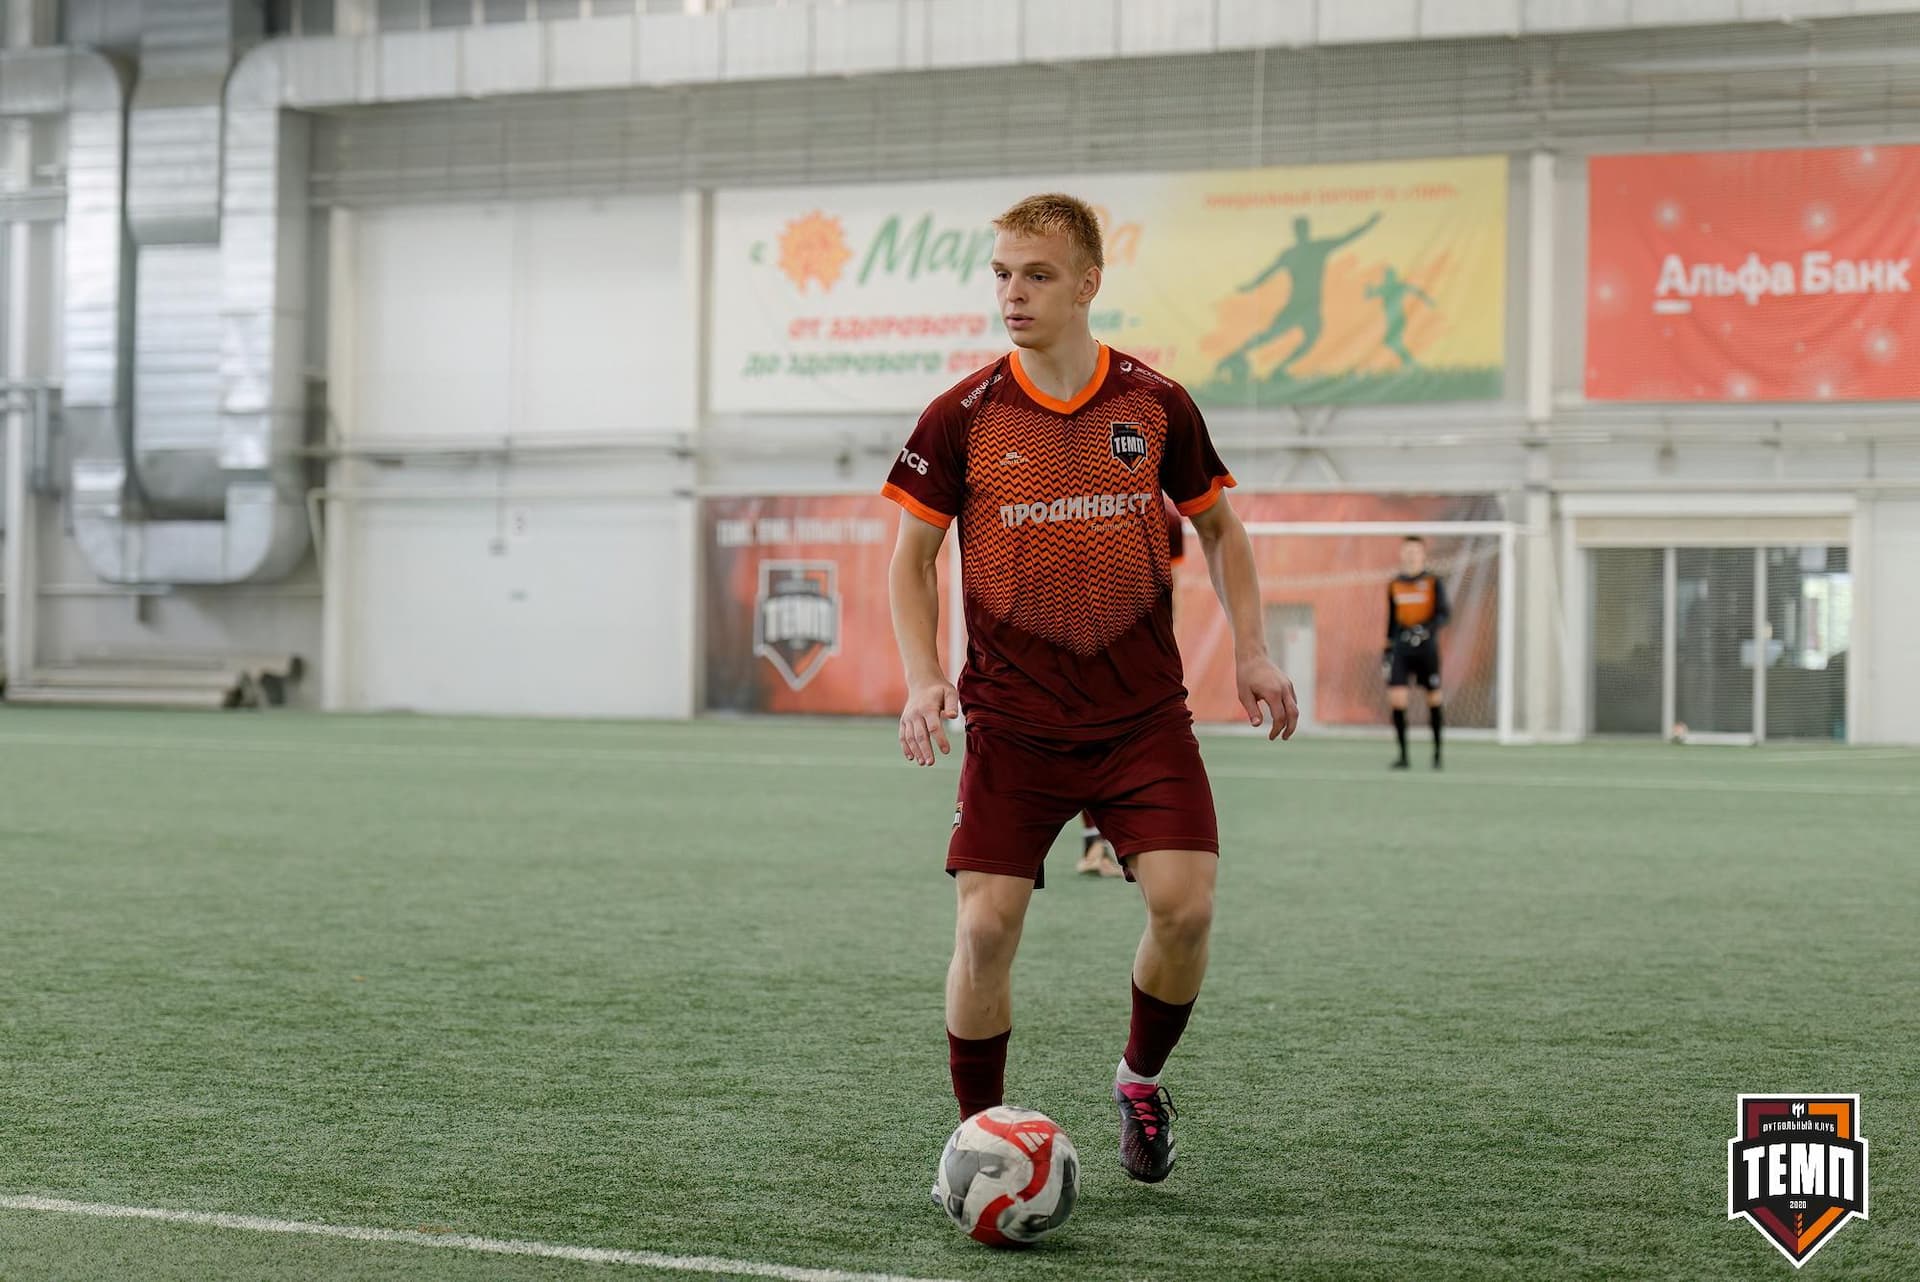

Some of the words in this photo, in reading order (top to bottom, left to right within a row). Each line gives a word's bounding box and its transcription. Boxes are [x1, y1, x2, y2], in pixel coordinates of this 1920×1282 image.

[1654, 252, 1796, 305] Альфа
[1802, 251, 1911, 294] Банк
[1113, 436, 1145, 454] ТЕМП
[1000, 493, 1152, 529] ПРОДИНВЕСТ
